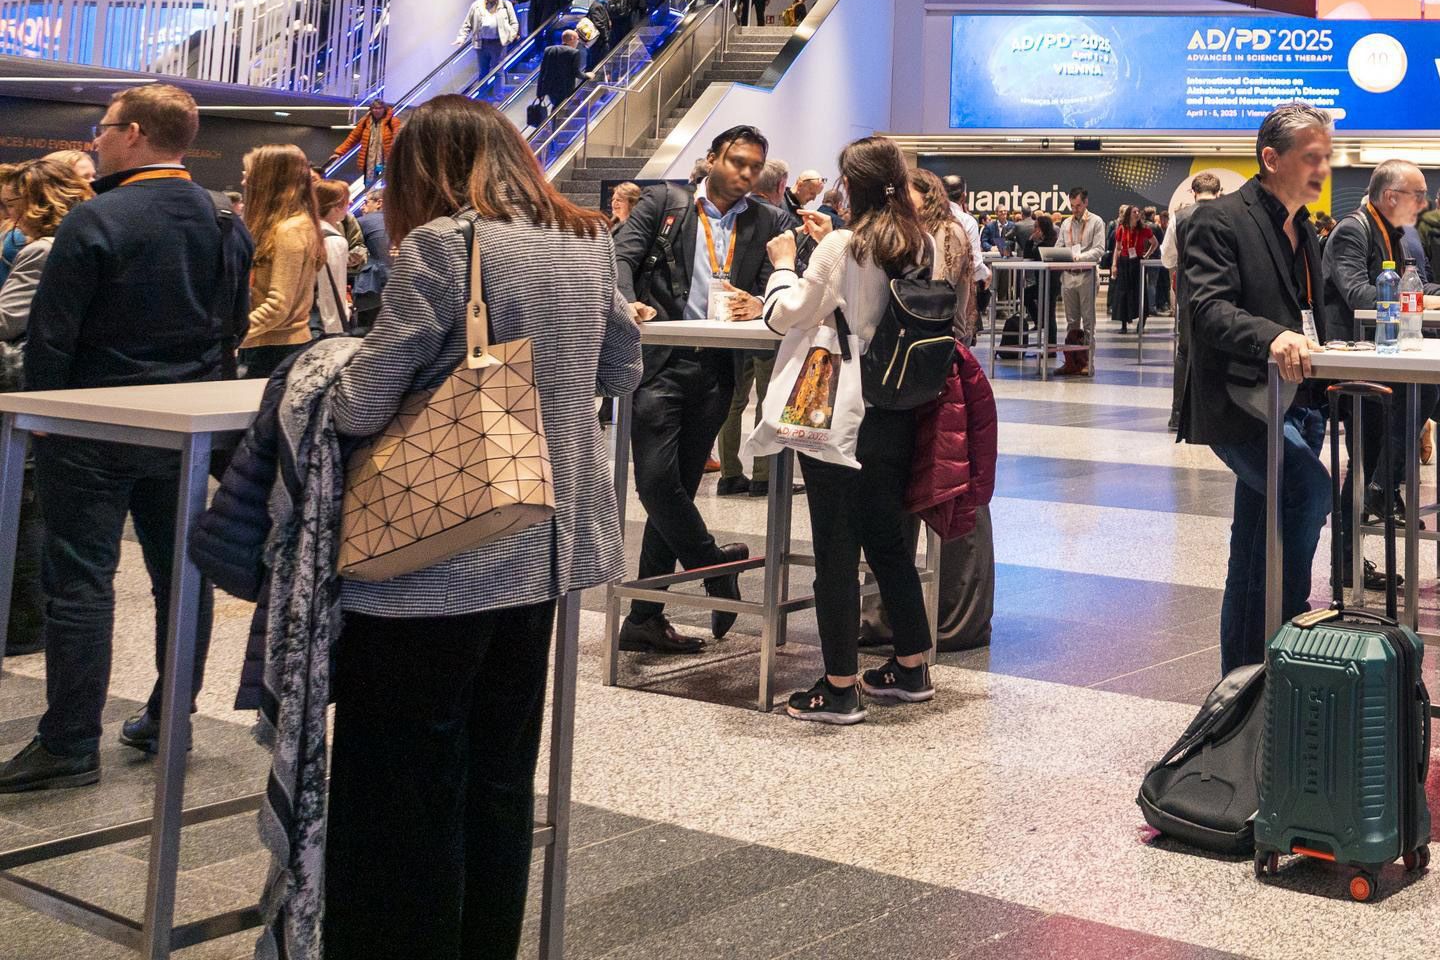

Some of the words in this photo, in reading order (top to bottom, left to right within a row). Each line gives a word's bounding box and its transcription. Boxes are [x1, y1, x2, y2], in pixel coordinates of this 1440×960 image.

[1078, 33, 1112, 54] 2025
[1278, 29, 1334, 51] 2025
[1187, 54, 1232, 62] ADVANCES
[1234, 54, 1244, 62] IN
[1246, 54, 1283, 62] SCIENCE
[1294, 54, 1333, 62] THERAPY
[1186, 77, 1241, 86] International
[1242, 77, 1292, 86] Conference
[1292, 78, 1303, 86] on
[1236, 87, 1252, 95] and
[1186, 96, 1203, 105] and
[1204, 96, 1238, 105] Related
[1239, 96, 1293, 107] Neurological
[1186, 109, 1203, 118] April
[968, 184, 1072, 212] anterix
[808, 431, 830, 442] 2025
